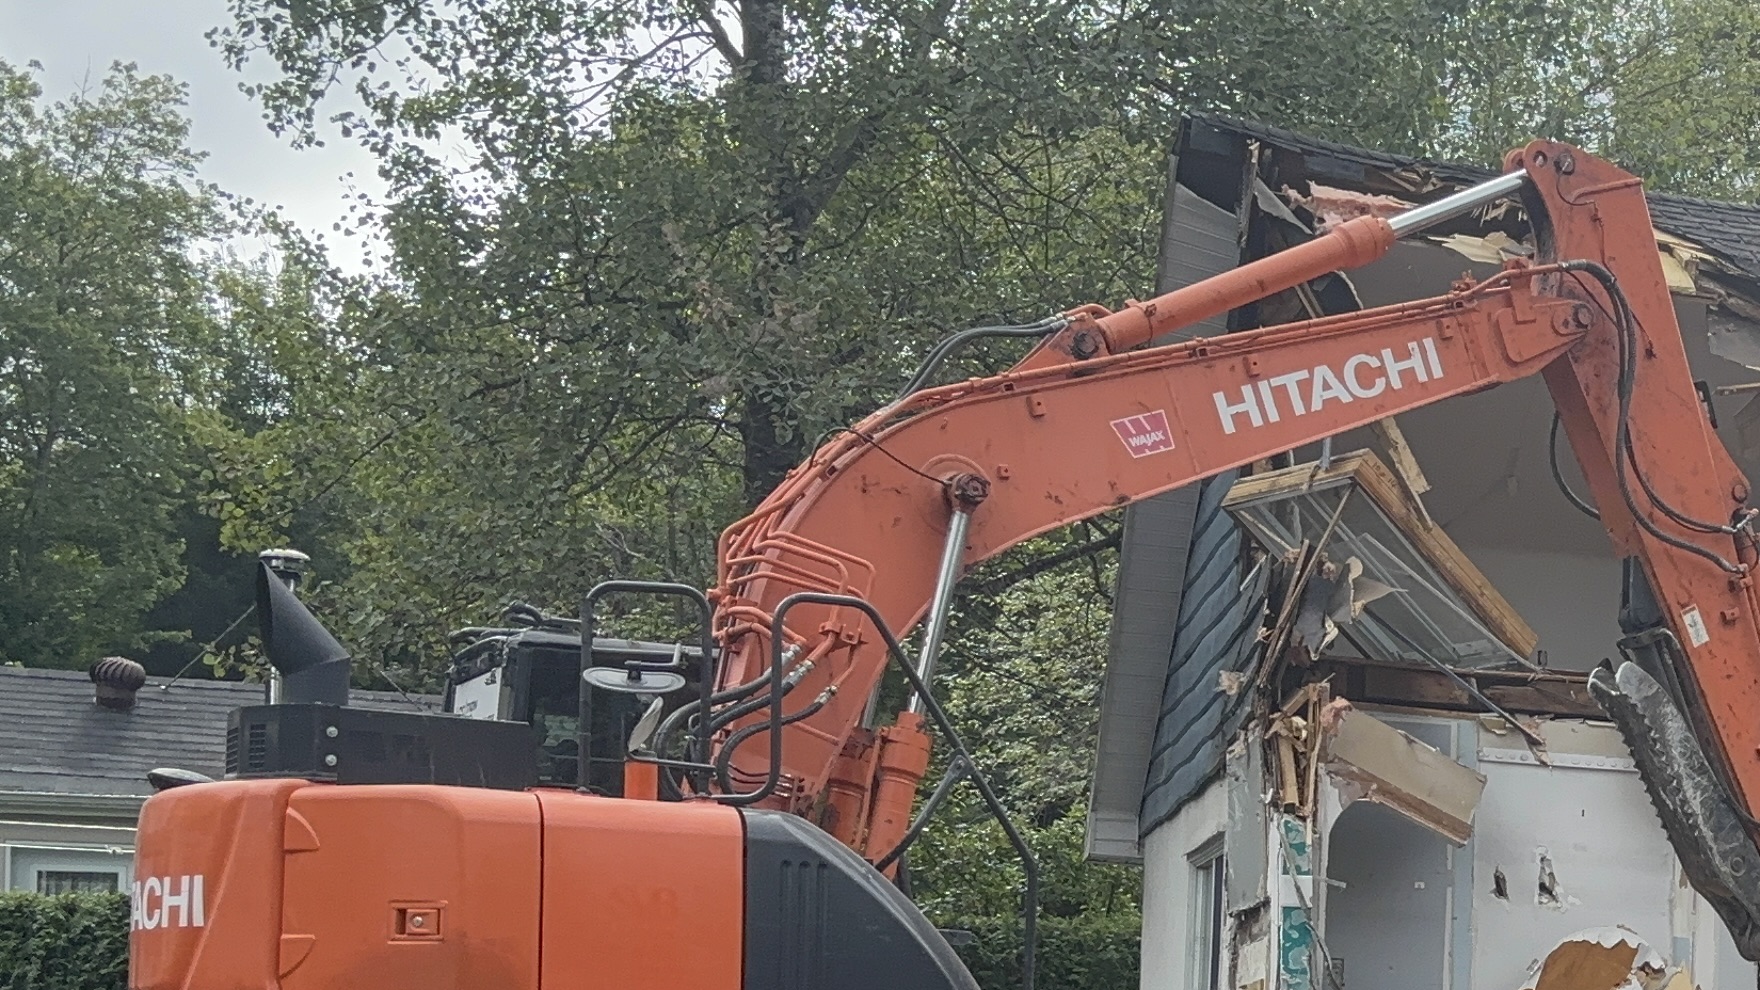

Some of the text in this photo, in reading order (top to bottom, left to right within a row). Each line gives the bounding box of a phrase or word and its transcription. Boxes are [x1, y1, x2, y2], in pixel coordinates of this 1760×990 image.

[1212, 337, 1444, 435] HITACHI
[1128, 430, 1165, 447] WAJAX
[130, 874, 204, 932] ACHI
